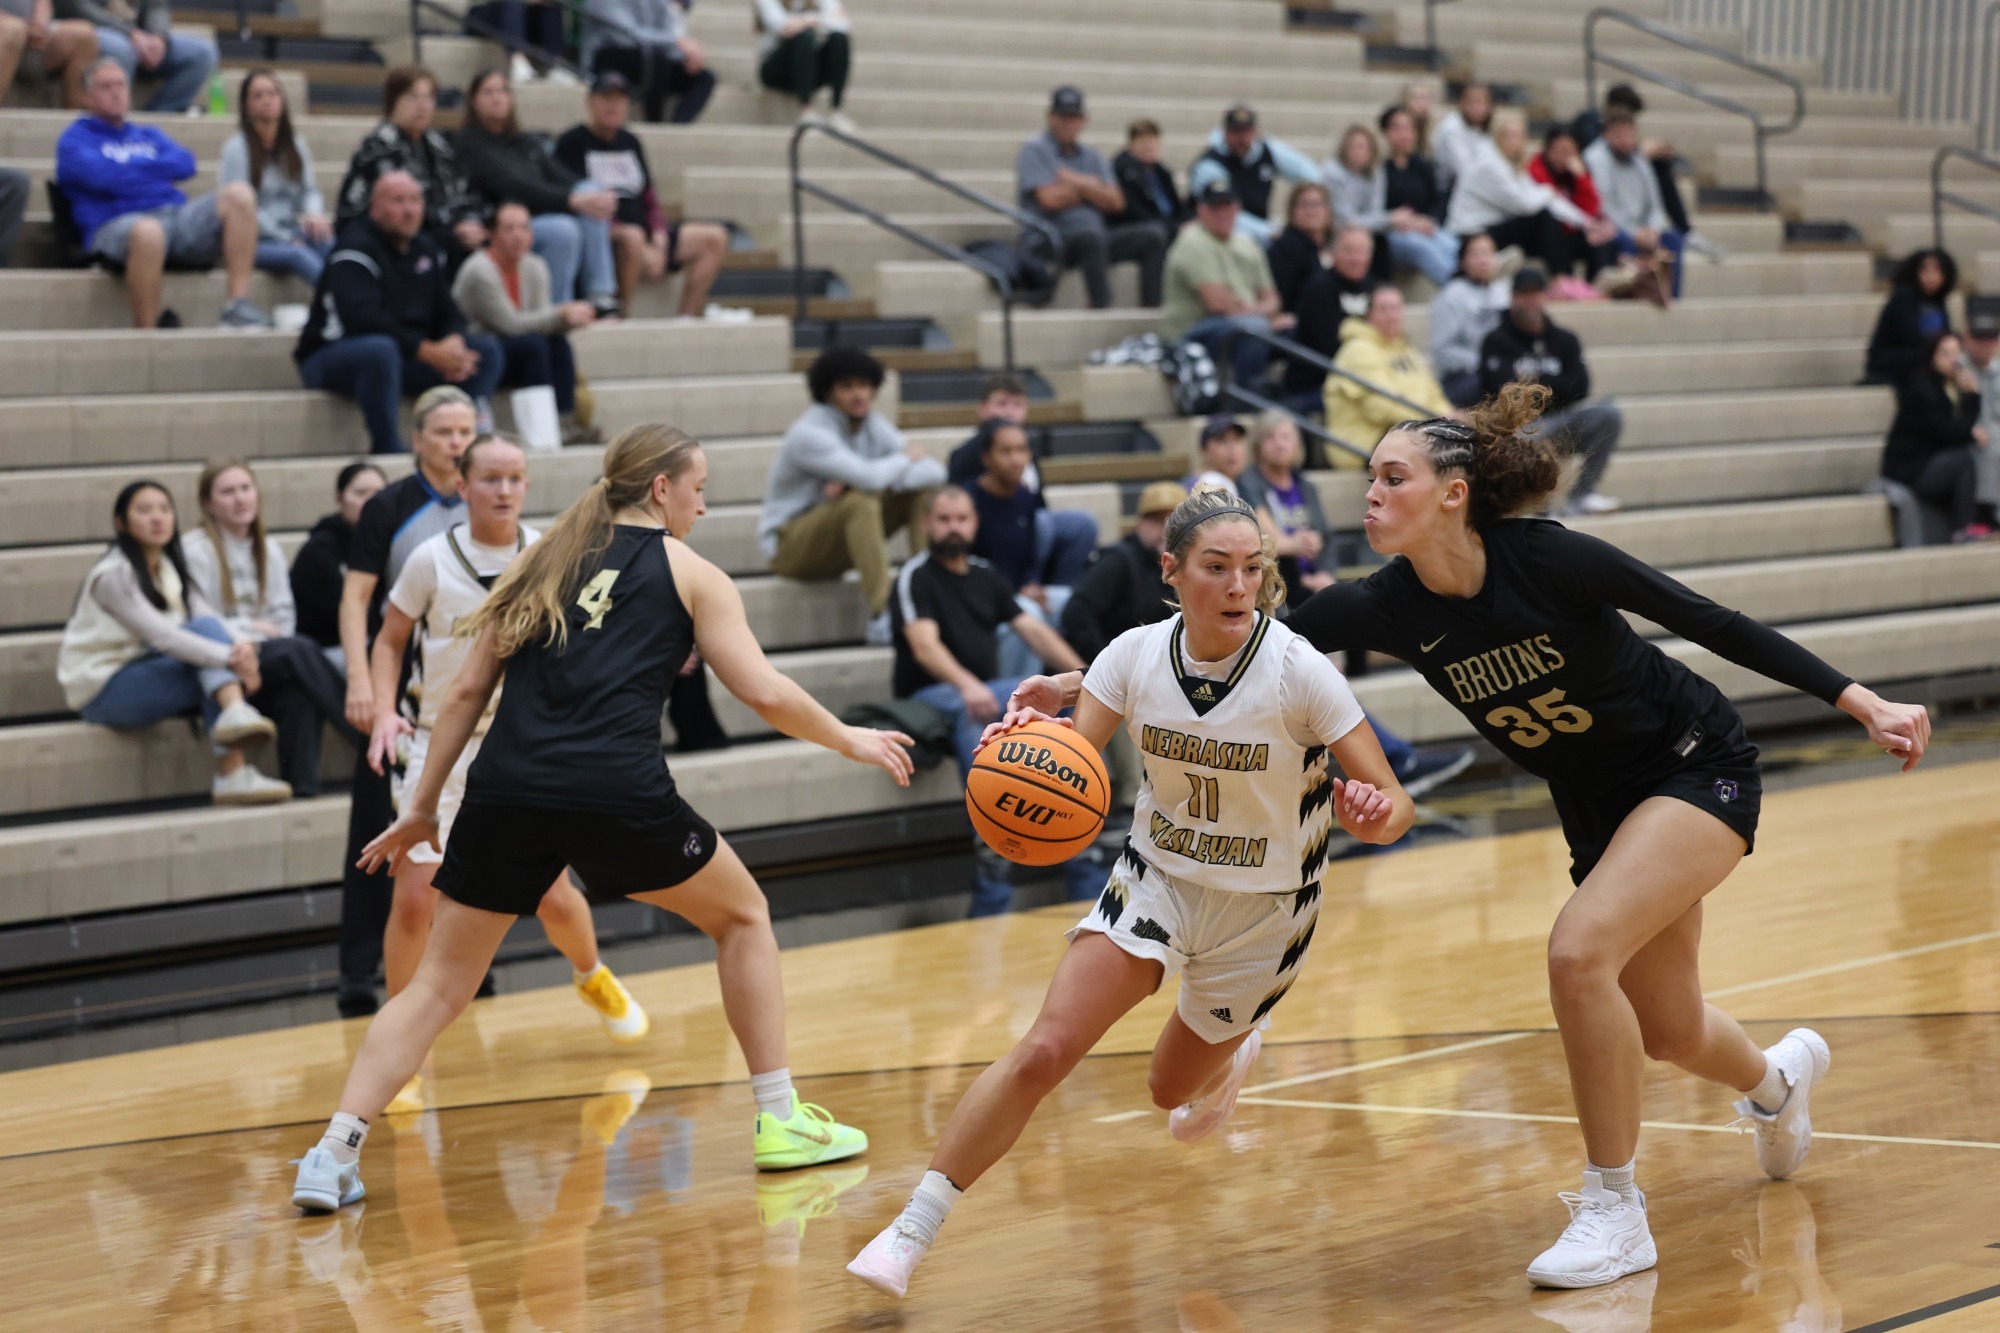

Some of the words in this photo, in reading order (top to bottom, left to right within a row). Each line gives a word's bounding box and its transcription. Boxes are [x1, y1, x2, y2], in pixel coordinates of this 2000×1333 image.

[576, 568, 620, 630] 4
[1443, 633, 1566, 704] BRUINS
[1191, 692, 1216, 702] adidas
[1485, 686, 1593, 749] 35
[997, 741, 1088, 796] Wilson
[1141, 723, 1269, 772] NEBRASKA
[995, 791, 1056, 826] EVO
[1184, 772, 1219, 823] 11
[1149, 810, 1268, 868] WESLEYAN
[1209, 1008, 1234, 1024] adidas
